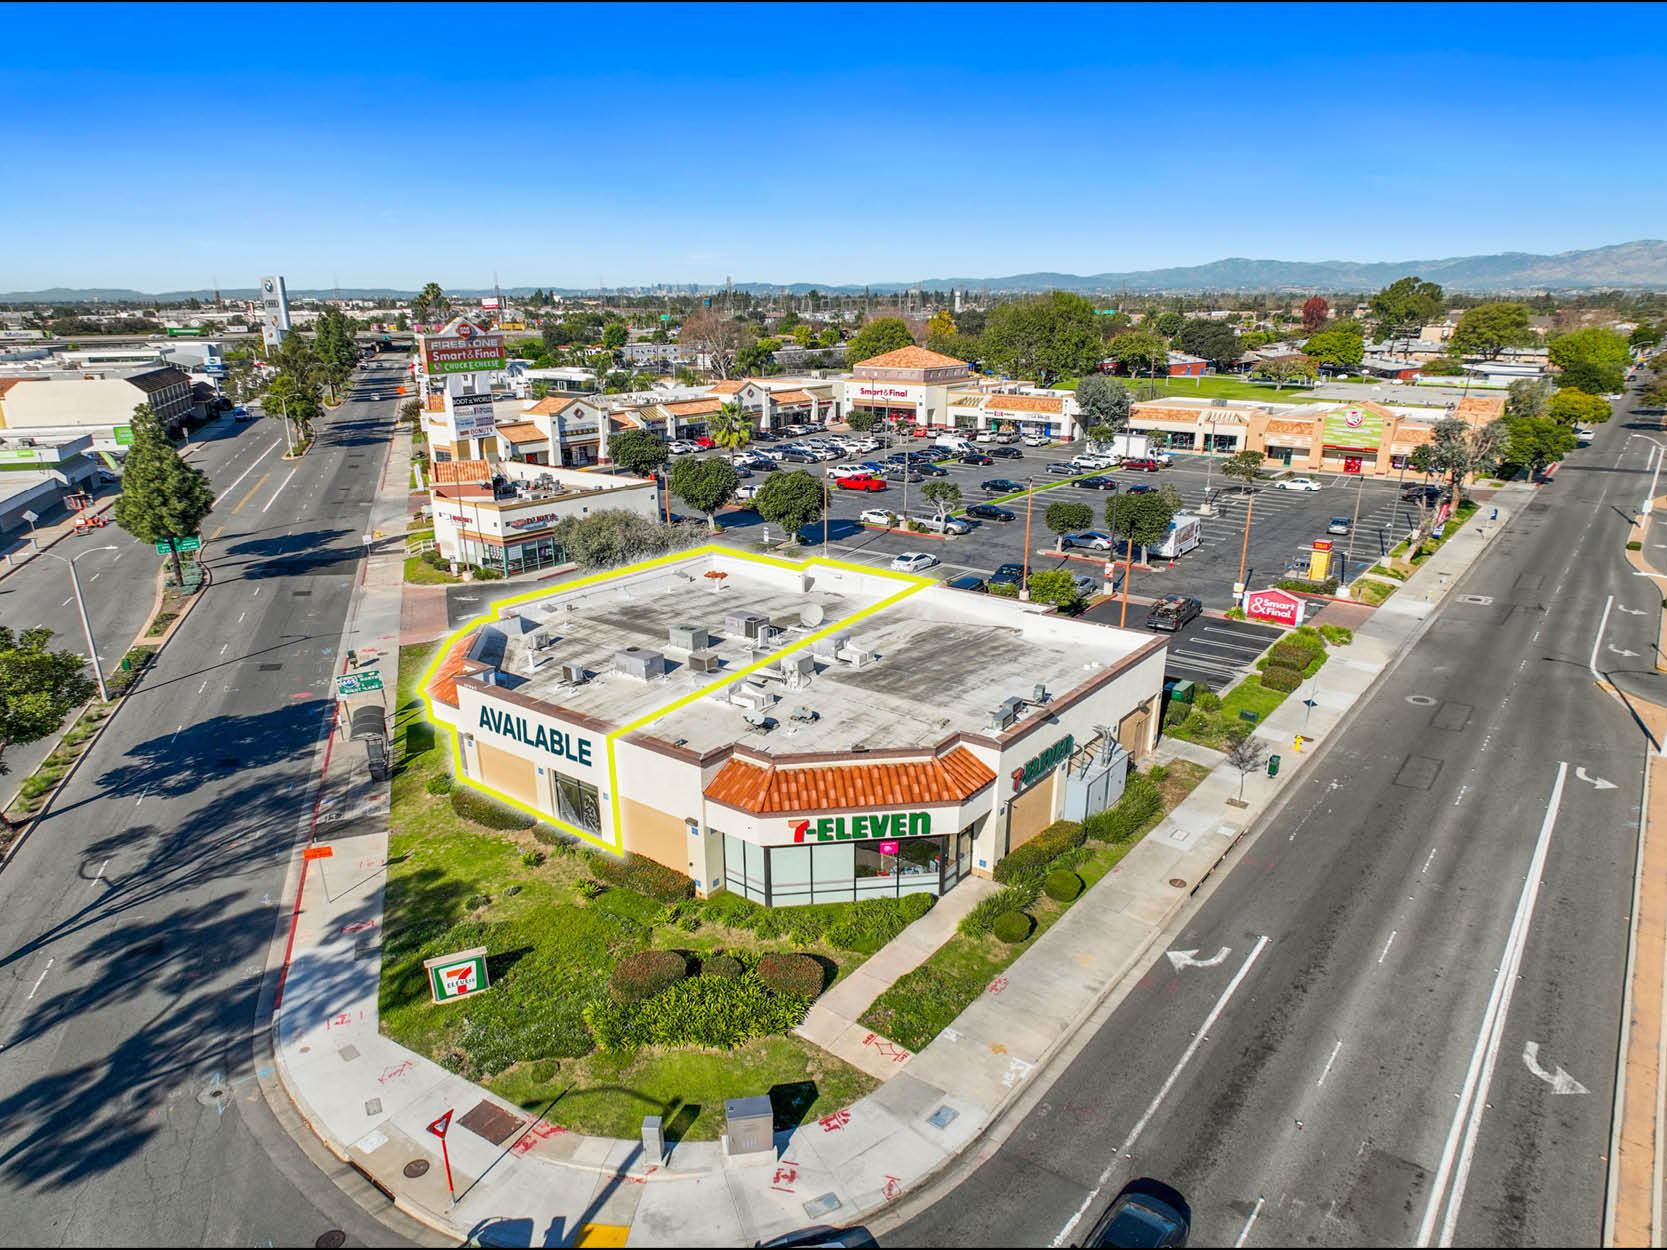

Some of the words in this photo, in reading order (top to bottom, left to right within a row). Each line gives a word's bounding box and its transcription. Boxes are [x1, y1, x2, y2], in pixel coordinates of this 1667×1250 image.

[1264, 598, 1295, 610] Smart
[1266, 607, 1291, 618] Final
[479, 705, 592, 767] AVAILABLE
